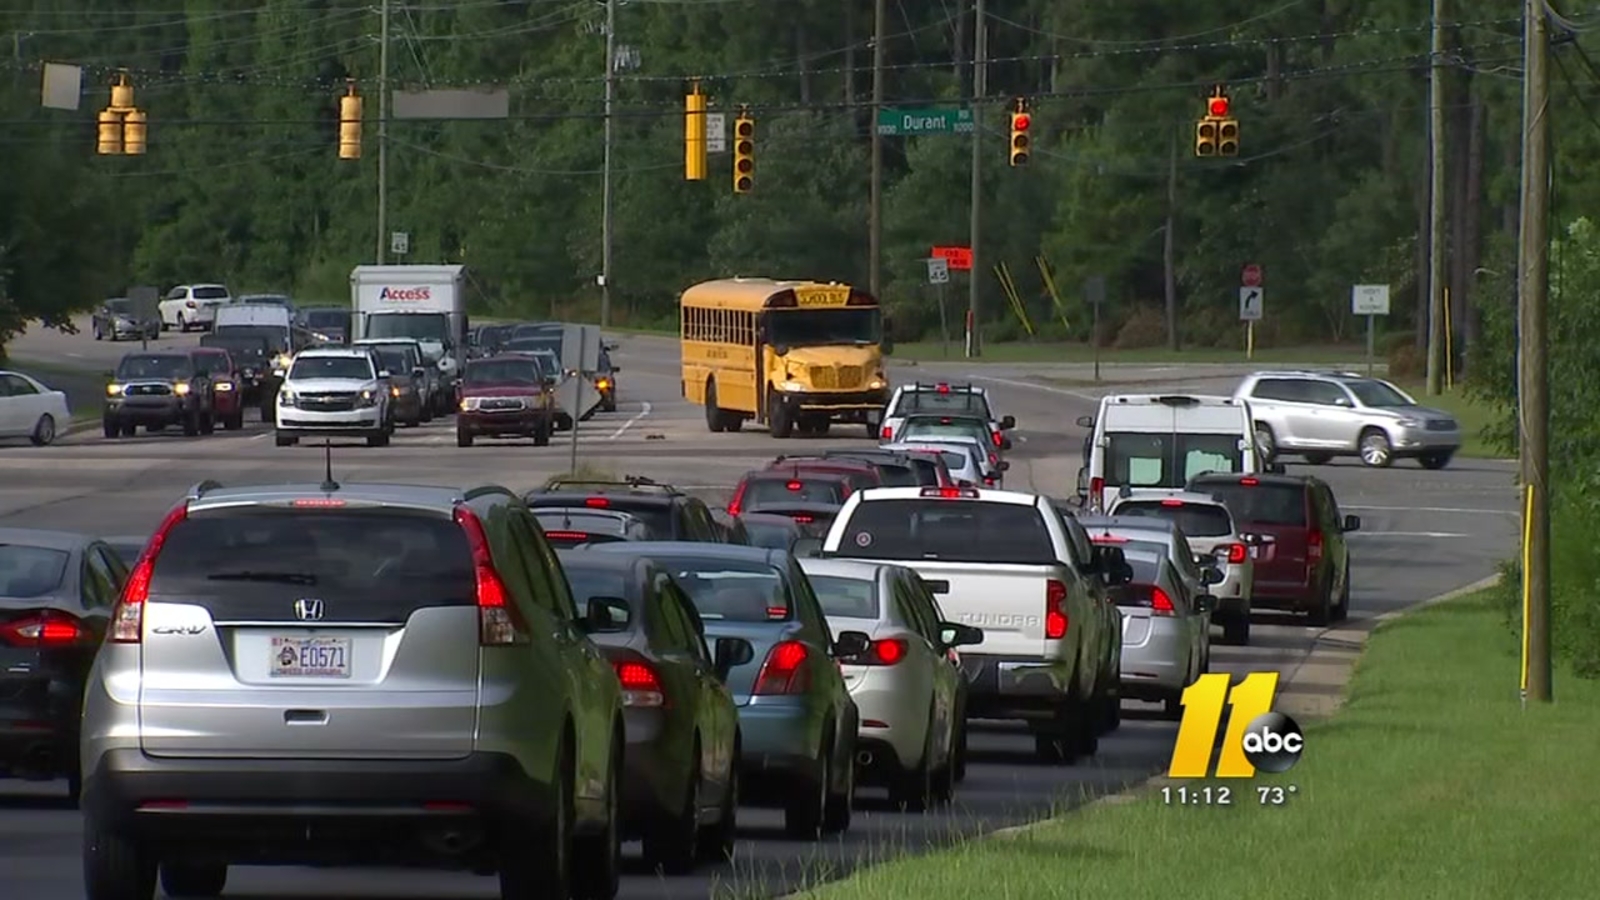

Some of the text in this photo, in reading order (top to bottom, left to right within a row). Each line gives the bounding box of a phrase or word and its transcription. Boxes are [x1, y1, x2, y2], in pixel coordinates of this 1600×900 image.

[903, 114, 946, 130] Durant
[380, 286, 430, 300] Access
[957, 613, 1041, 627] TUNDRA
